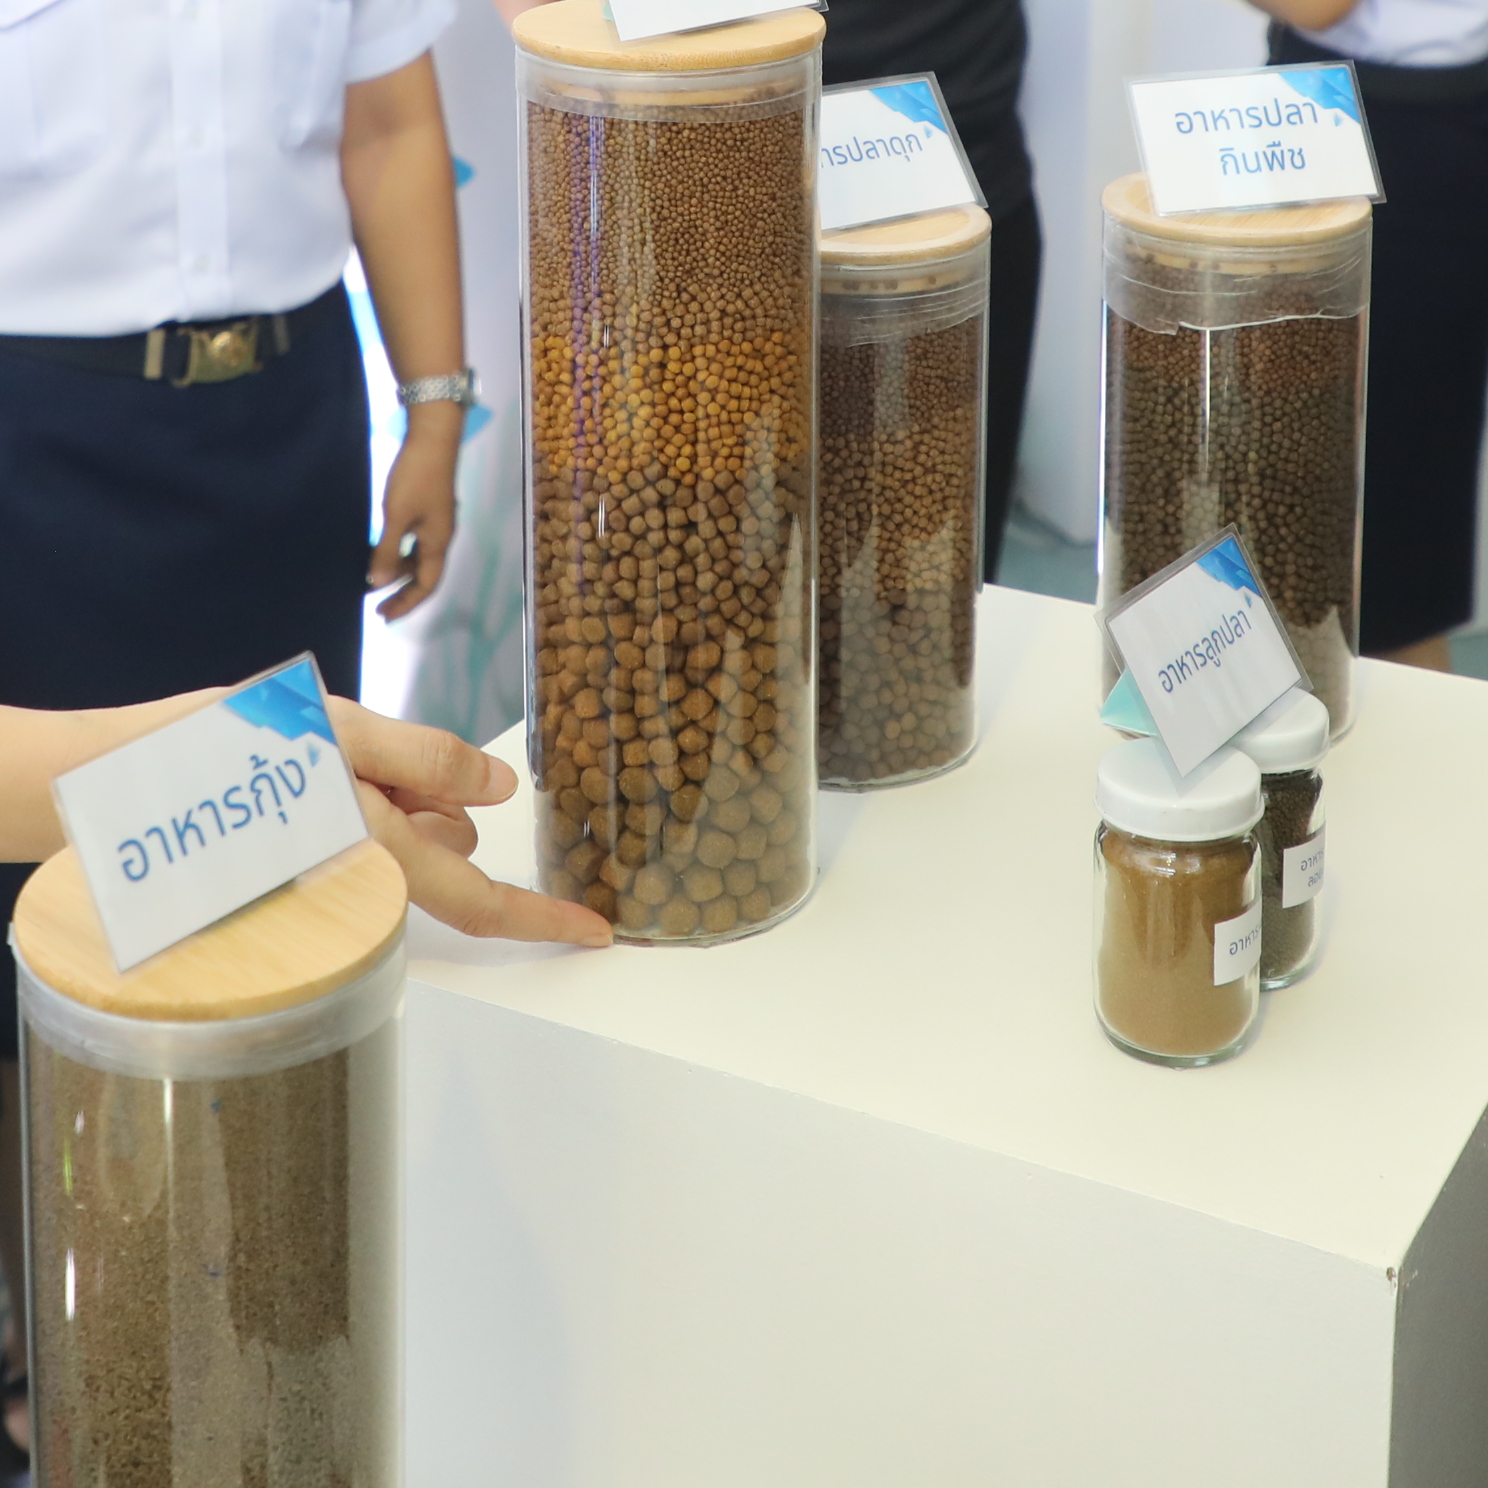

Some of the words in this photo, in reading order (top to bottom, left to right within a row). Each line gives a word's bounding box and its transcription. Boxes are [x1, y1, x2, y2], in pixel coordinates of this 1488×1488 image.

[1174, 98, 1318, 135] อาหารปลา
[820, 133, 923, 168] ารปลาดุก
[1218, 140, 1307, 176] กินพืช
[1157, 609, 1253, 693] อาหารลูกปลา
[117, 754, 307, 883] อาหารกุ้ง
[1229, 924, 1261, 956] อาหาร
